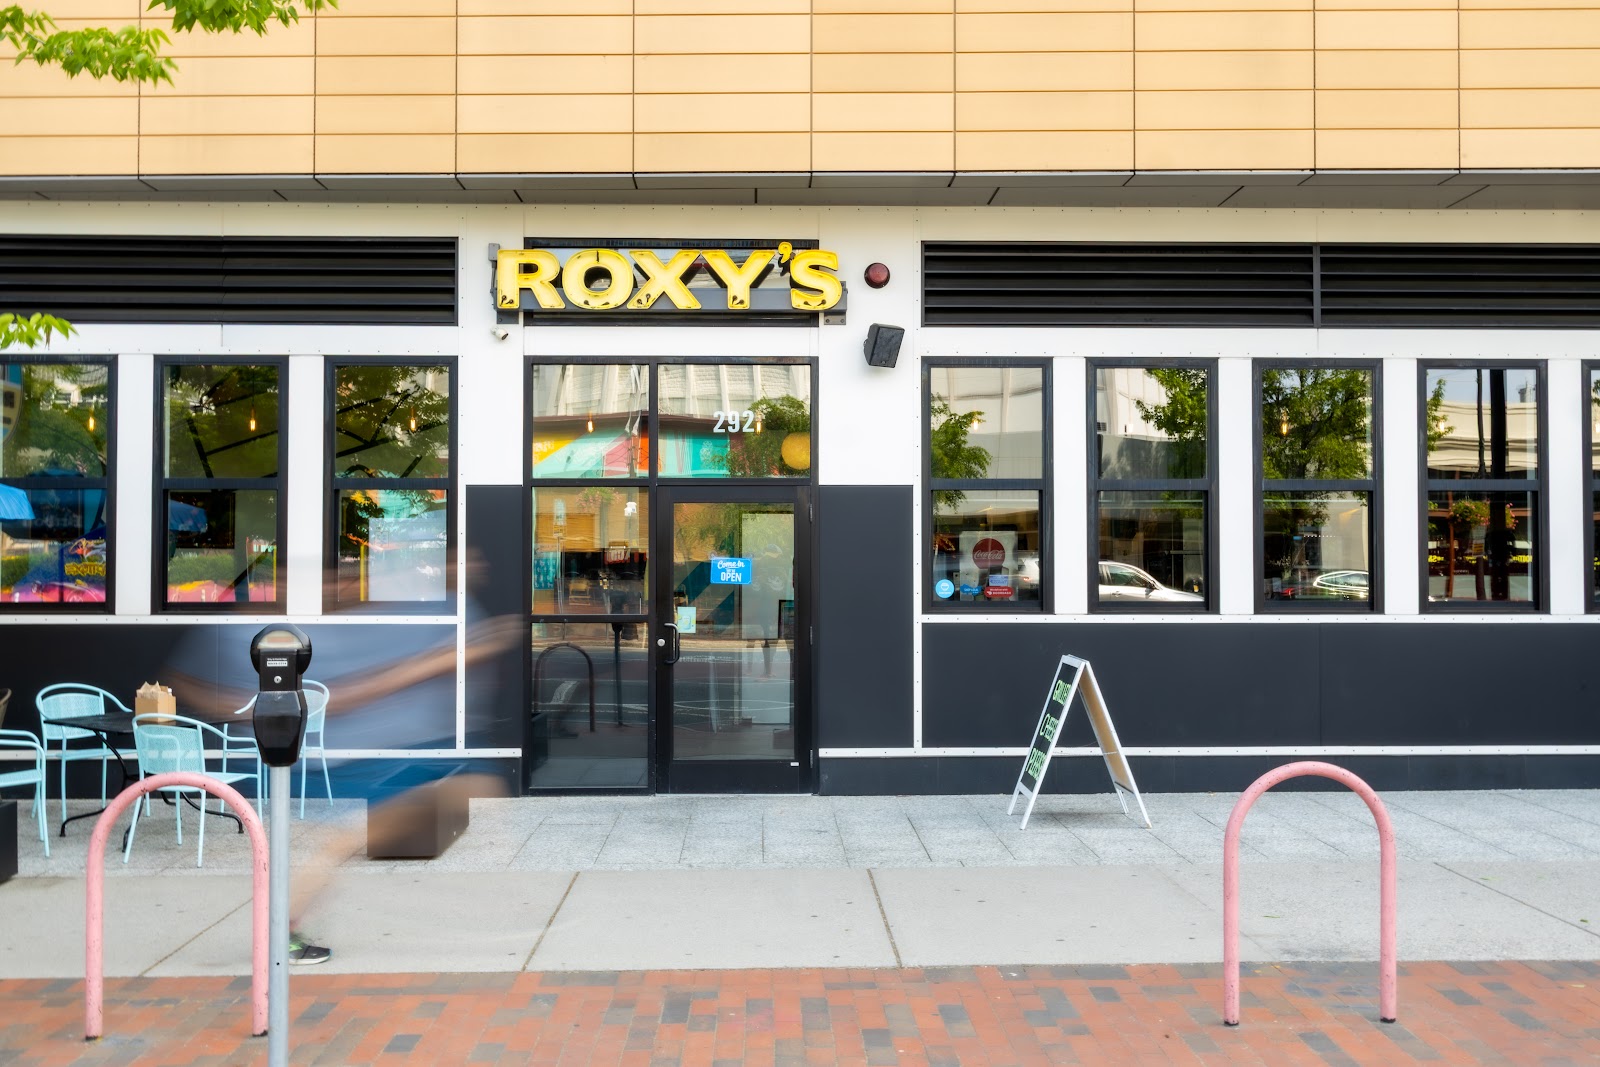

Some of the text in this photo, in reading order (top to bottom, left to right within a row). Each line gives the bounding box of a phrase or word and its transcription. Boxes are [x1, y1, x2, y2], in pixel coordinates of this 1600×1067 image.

[497, 241, 843, 310] ROXY'S
[713, 411, 755, 433] 292
[717, 560, 737, 569] Come
[720, 572, 742, 582] OPEN
